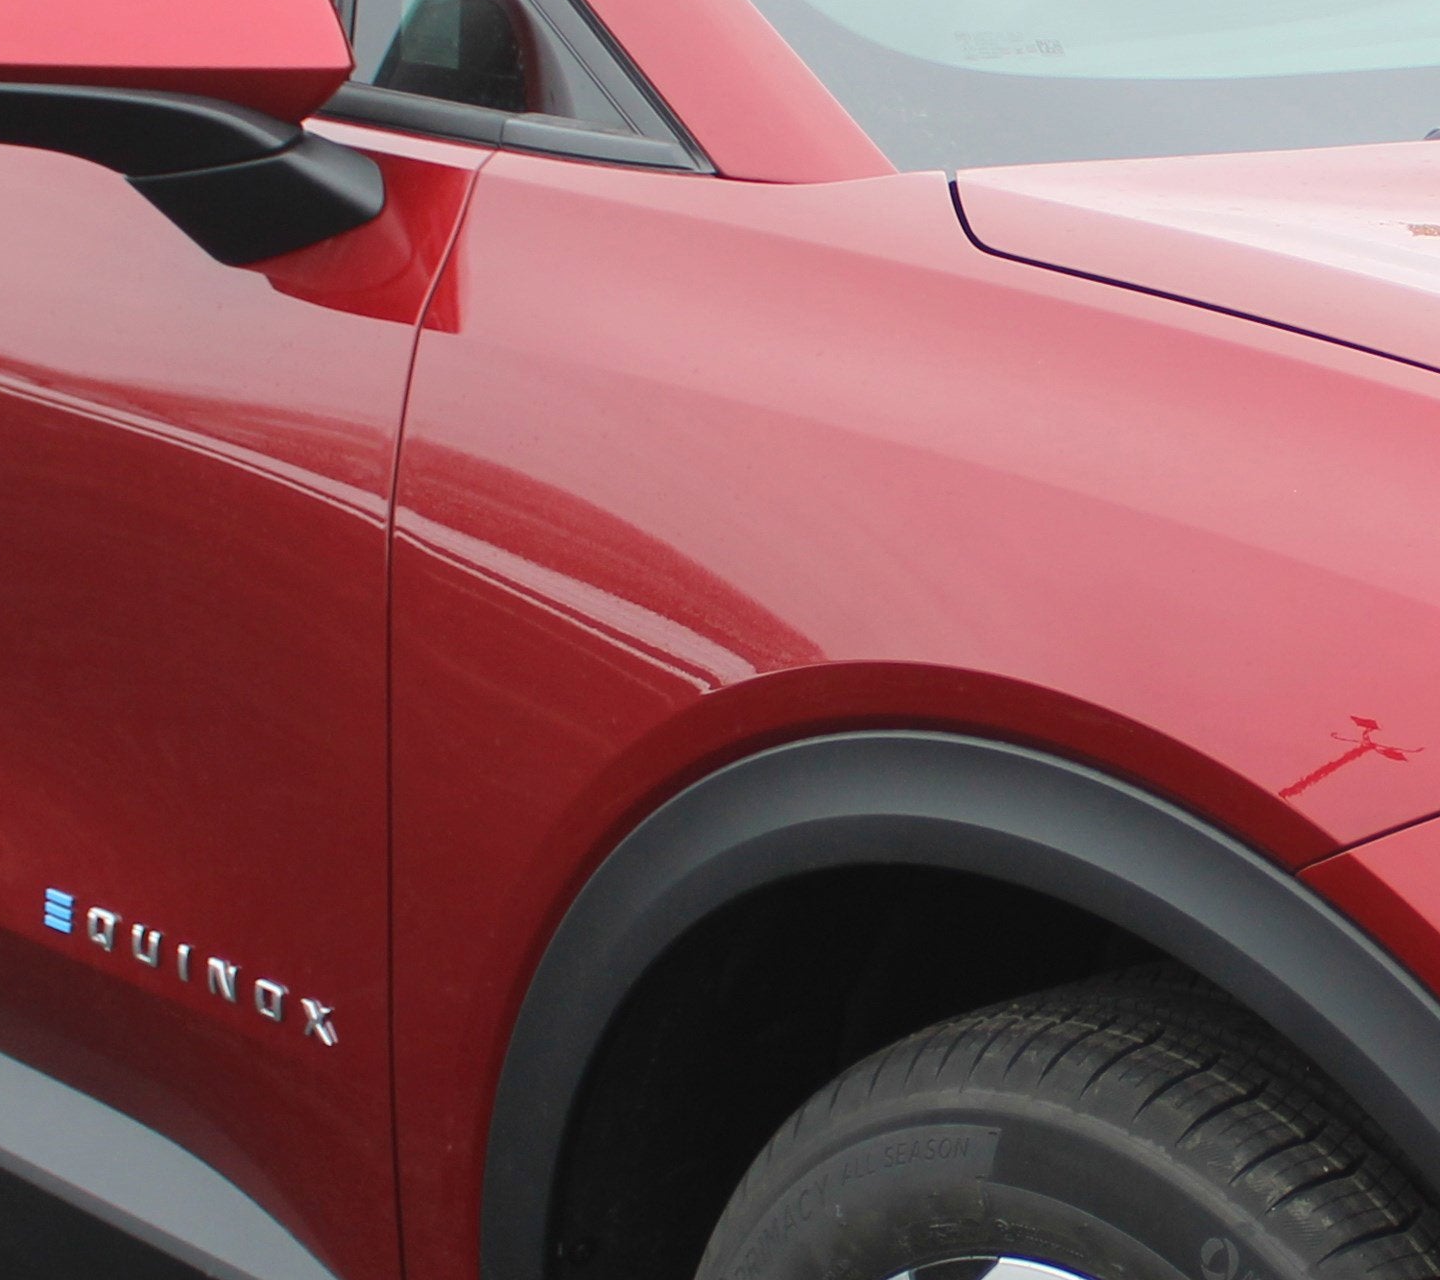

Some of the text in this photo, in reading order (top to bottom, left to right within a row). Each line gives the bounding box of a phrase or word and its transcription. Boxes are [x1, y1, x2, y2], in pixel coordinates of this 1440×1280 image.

[44, 888, 338, 1046] EQUINOX
[840, 1153, 877, 1187] ALL
[883, 1136, 971, 1169] SEASON
